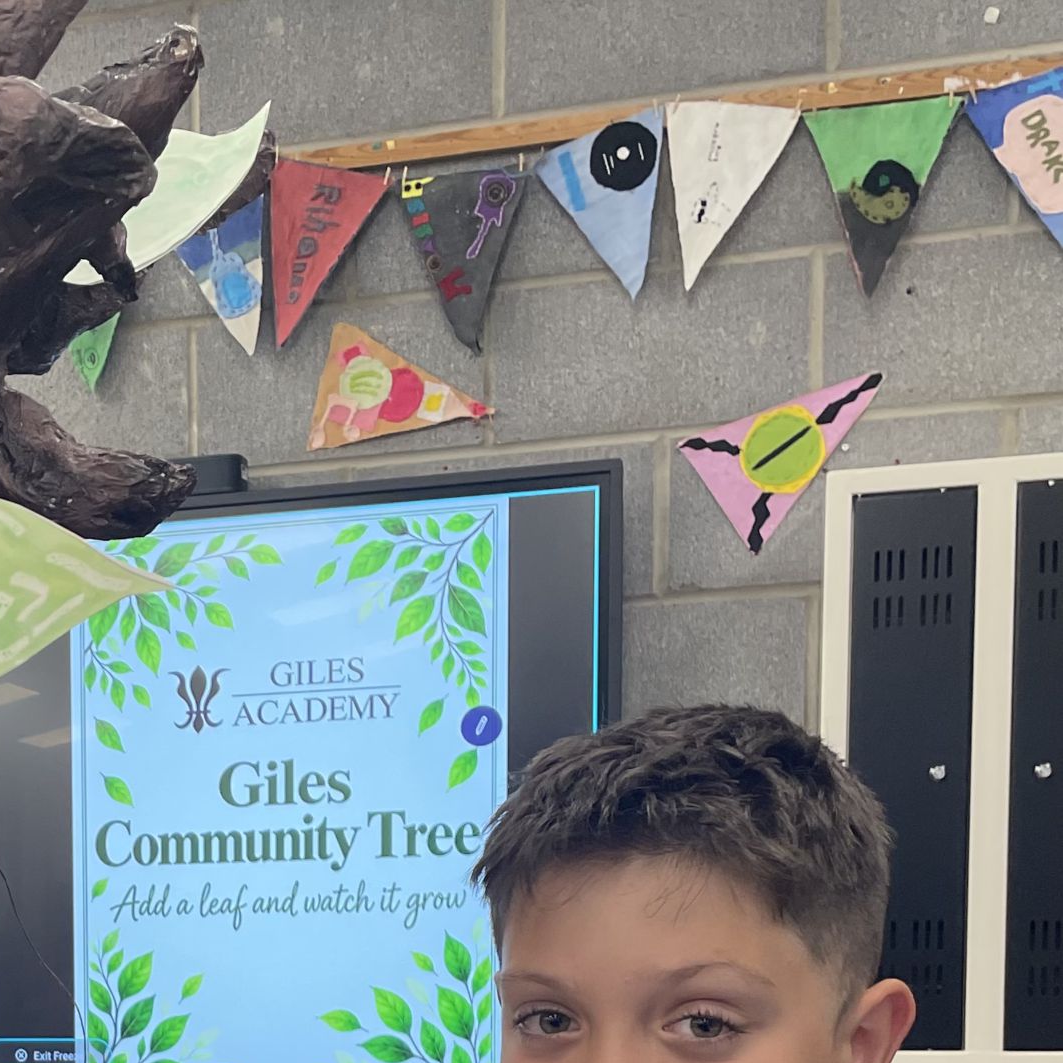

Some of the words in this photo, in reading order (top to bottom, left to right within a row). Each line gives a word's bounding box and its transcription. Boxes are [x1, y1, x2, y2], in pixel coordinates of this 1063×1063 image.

[270, 656, 365, 687] GILES
[232, 693, 400, 727] ACADEMY
[218, 759, 352, 807] Giles
[95, 813, 361, 871] Community
[367, 810, 481, 860] Tree
[110, 883, 172, 923] Add
[176, 898, 194, 916] a
[199, 881, 249, 931] leaf
[252, 880, 299, 917] and
[304, 879, 375, 914] watch
[380, 882, 402, 914] it
[404, 889, 467, 930] grow
[33, 1051, 51, 1061] Exit
[53, 1051, 76, 1061] Free
